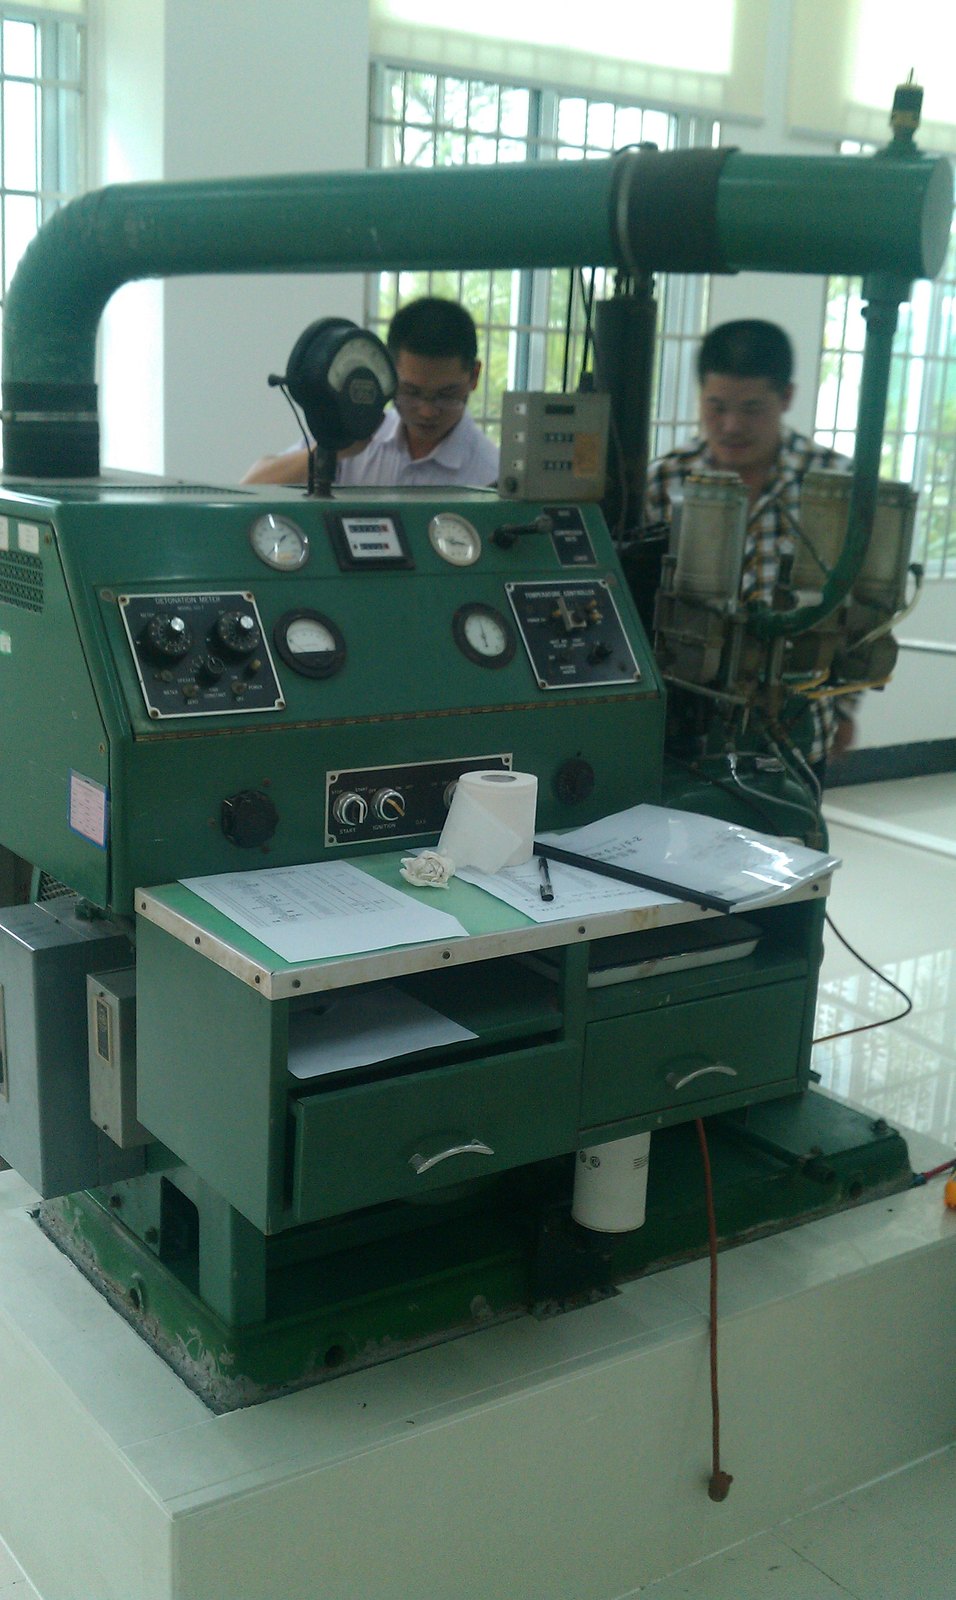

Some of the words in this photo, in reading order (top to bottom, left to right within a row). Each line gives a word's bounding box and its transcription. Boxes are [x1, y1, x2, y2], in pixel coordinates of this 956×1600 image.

[155, 597, 196, 605] DETONATION
[339, 827, 356, 835] START
[372, 823, 396, 831] IGNITION
